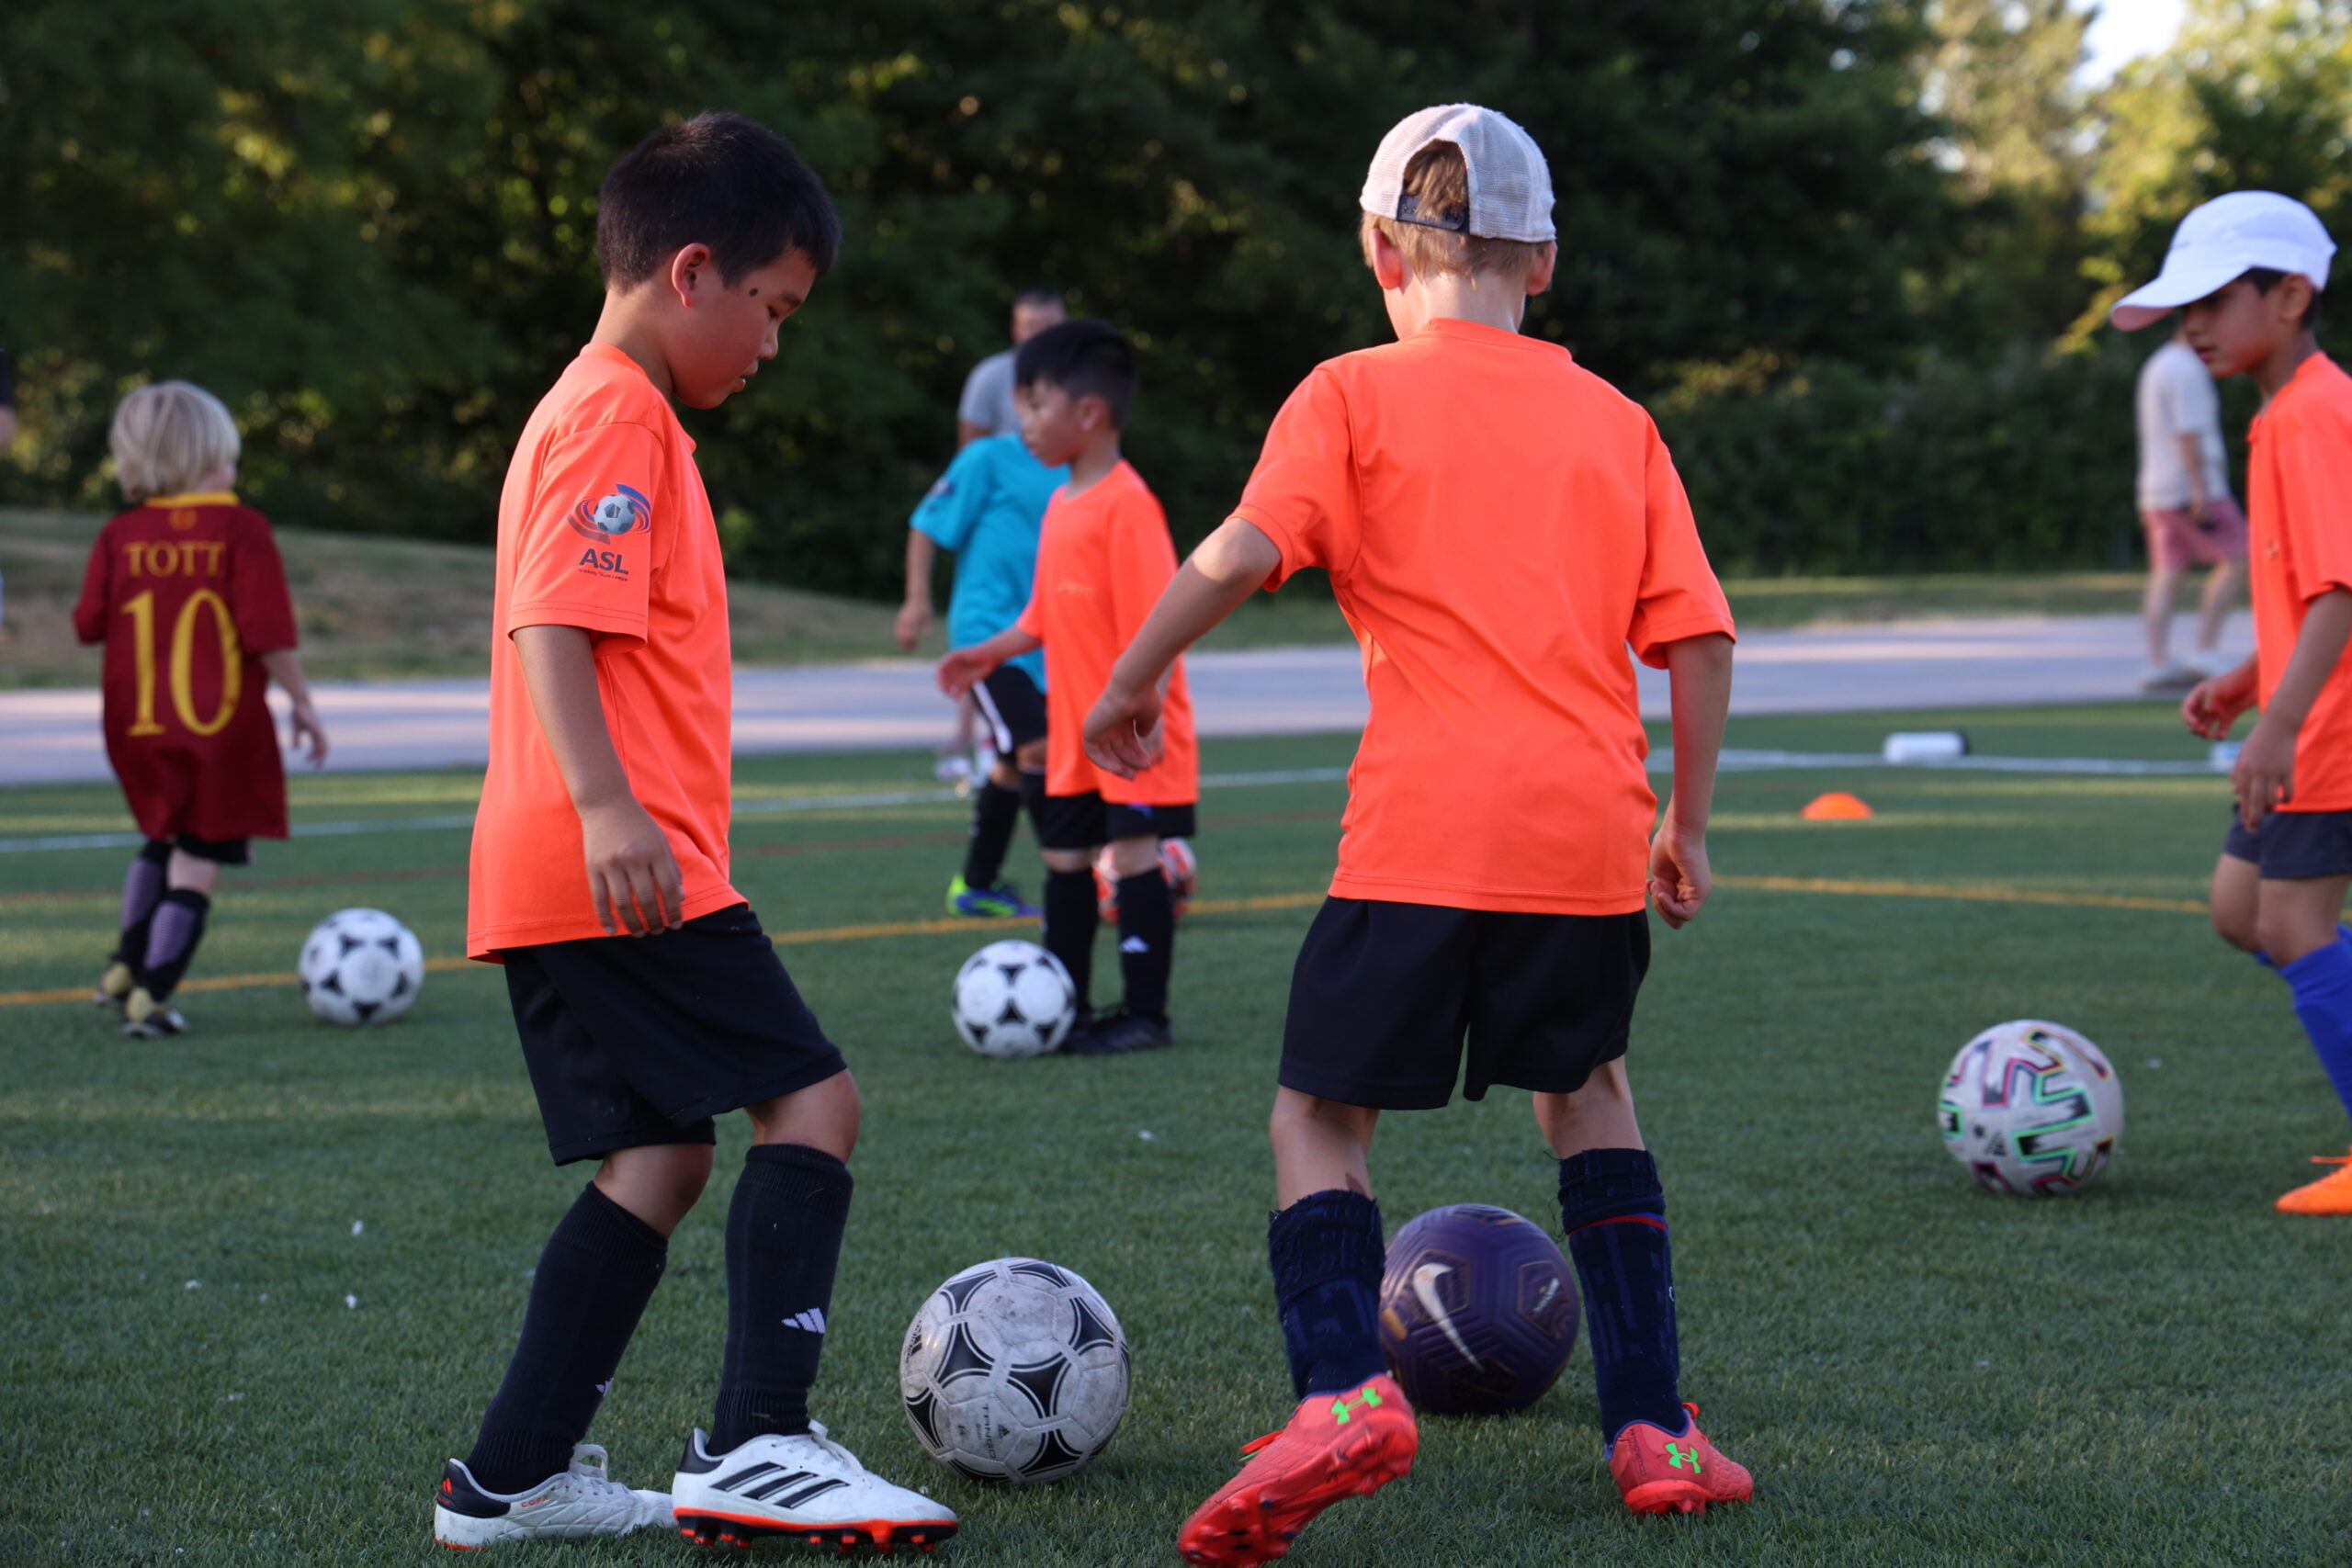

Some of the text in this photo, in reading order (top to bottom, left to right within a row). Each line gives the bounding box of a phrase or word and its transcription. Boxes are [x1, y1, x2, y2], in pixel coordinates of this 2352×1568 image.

[122, 540, 226, 578] TOTT
[579, 548, 629, 575] ASL
[119, 587, 243, 737] 10
[982, 1403, 997, 1459] TANGO
[520, 1495, 550, 1509] COPA
